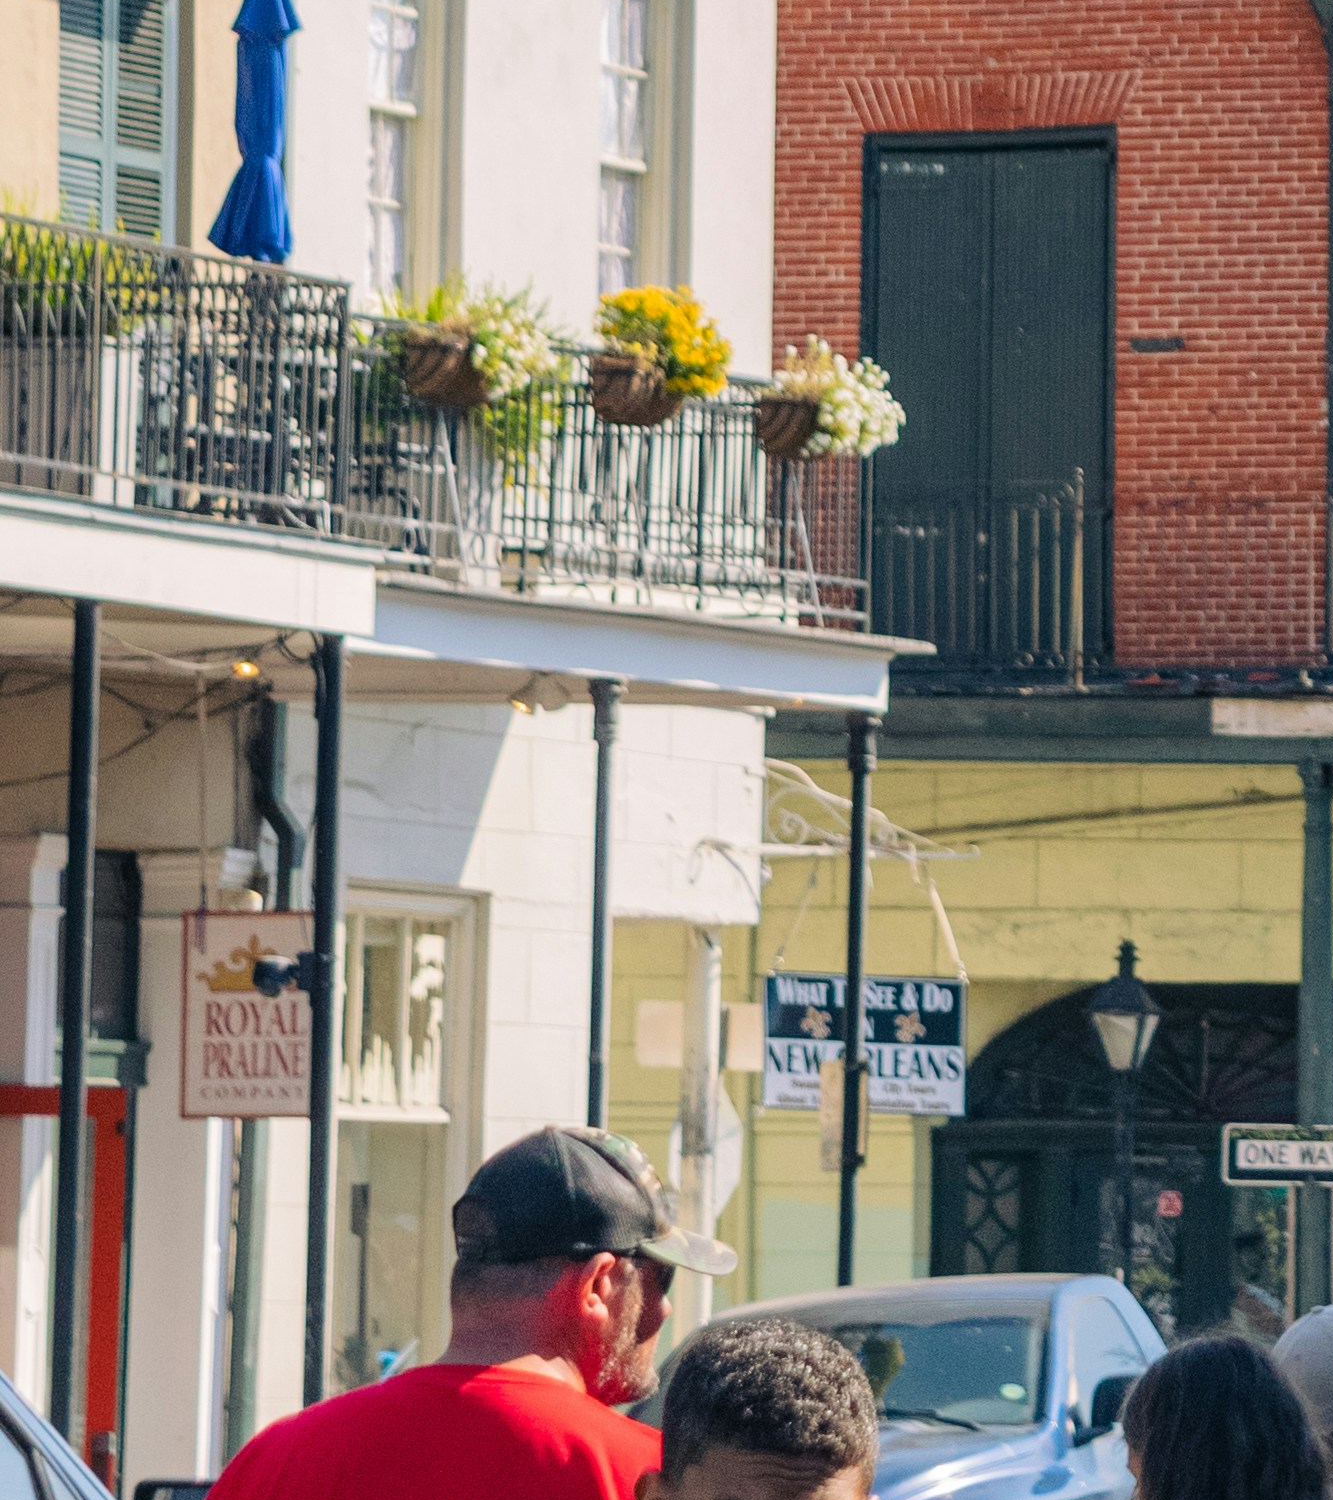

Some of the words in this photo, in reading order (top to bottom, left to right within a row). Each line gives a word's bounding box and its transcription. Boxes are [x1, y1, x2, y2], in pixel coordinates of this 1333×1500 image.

[776, 976, 829, 1007] WHAT
[900, 982, 919, 1012] &
[922, 983, 955, 1013] DO
[205, 1000, 308, 1036] ROYAL
[203, 1041, 305, 1078] PRALINE
[768, 1043, 822, 1075] NEW
[1245, 1143, 1289, 1164] ONE
